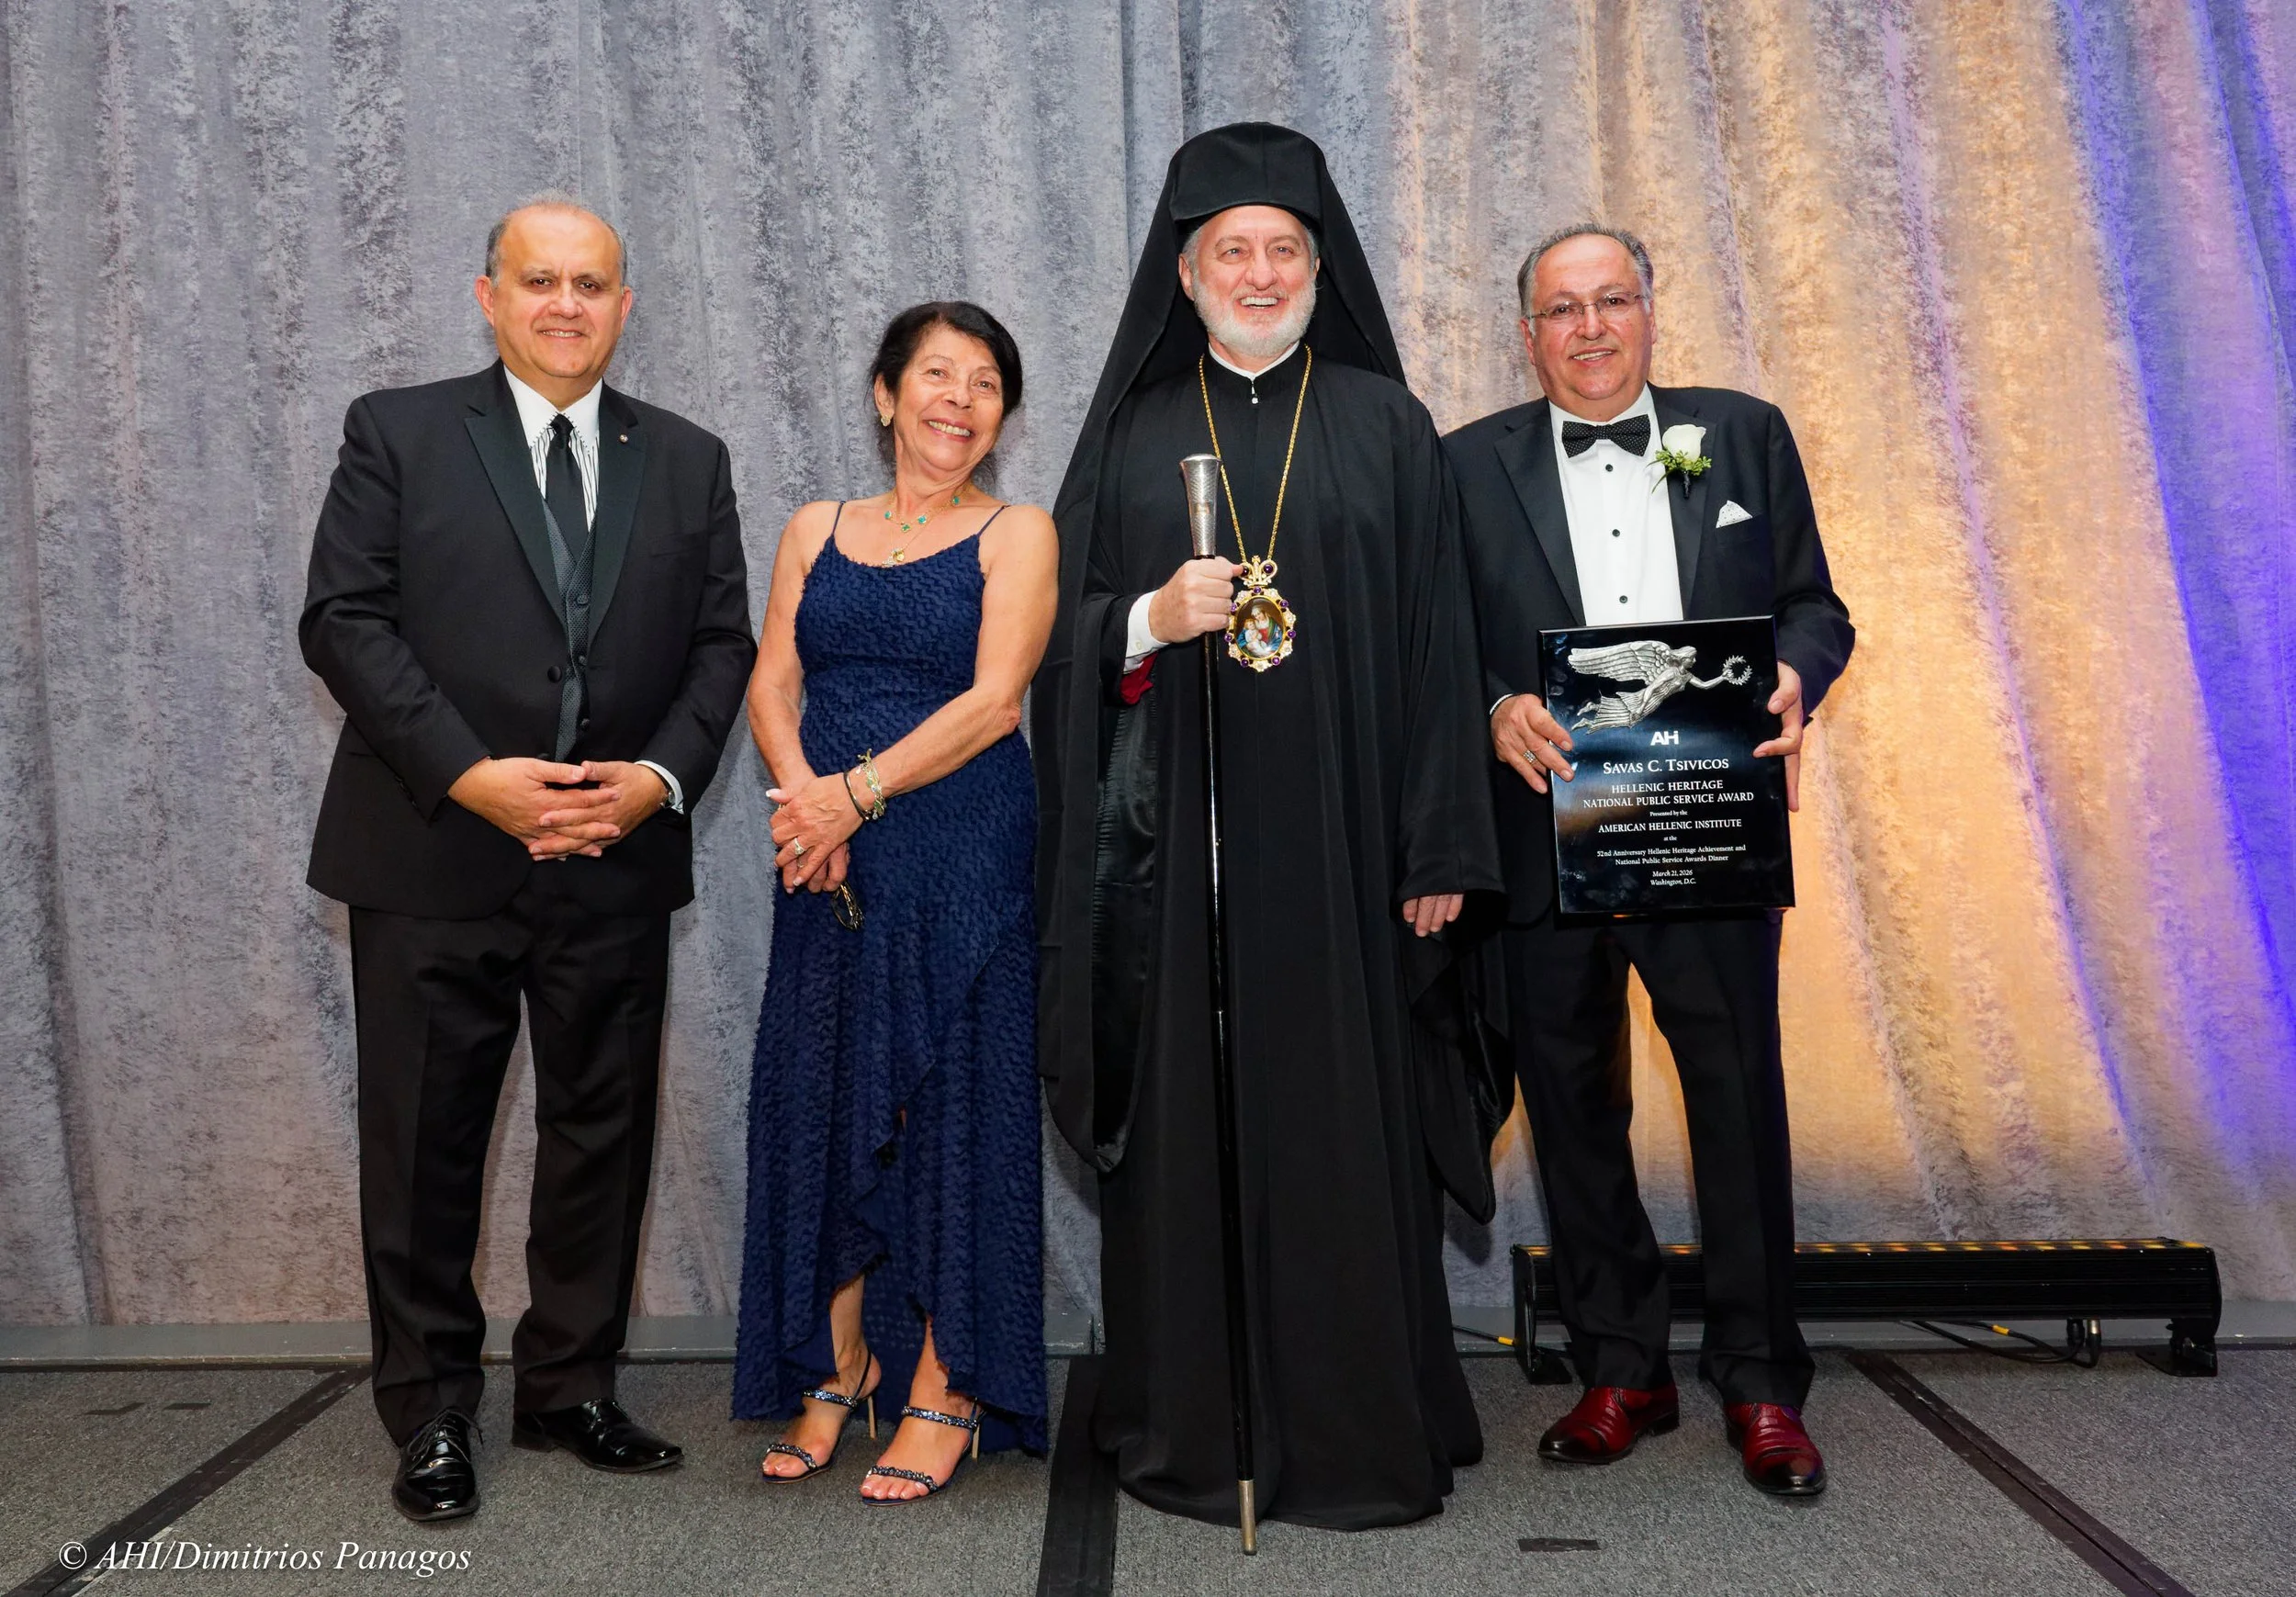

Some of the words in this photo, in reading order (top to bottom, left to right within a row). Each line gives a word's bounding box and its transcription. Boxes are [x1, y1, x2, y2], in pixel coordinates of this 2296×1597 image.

[1603, 762, 1644, 774] SAVAS
[1648, 759, 1662, 772] C.
[1666, 759, 1729, 771] TSIVICOS
[1611, 782, 1665, 793] HELLENIC
[1668, 780, 1724, 792] HERITAGE
[1582, 797, 1633, 808] NATIONAL
[1636, 795, 1671, 806] PUBLIC
[1673, 793, 1715, 804] SERVICE
[1716, 792, 1754, 803] AWARD
[1598, 823, 1647, 833] AMERICAN
[1649, 821, 1693, 831] HELLENIC
[1694, 818, 1742, 829] INSTITUTE
